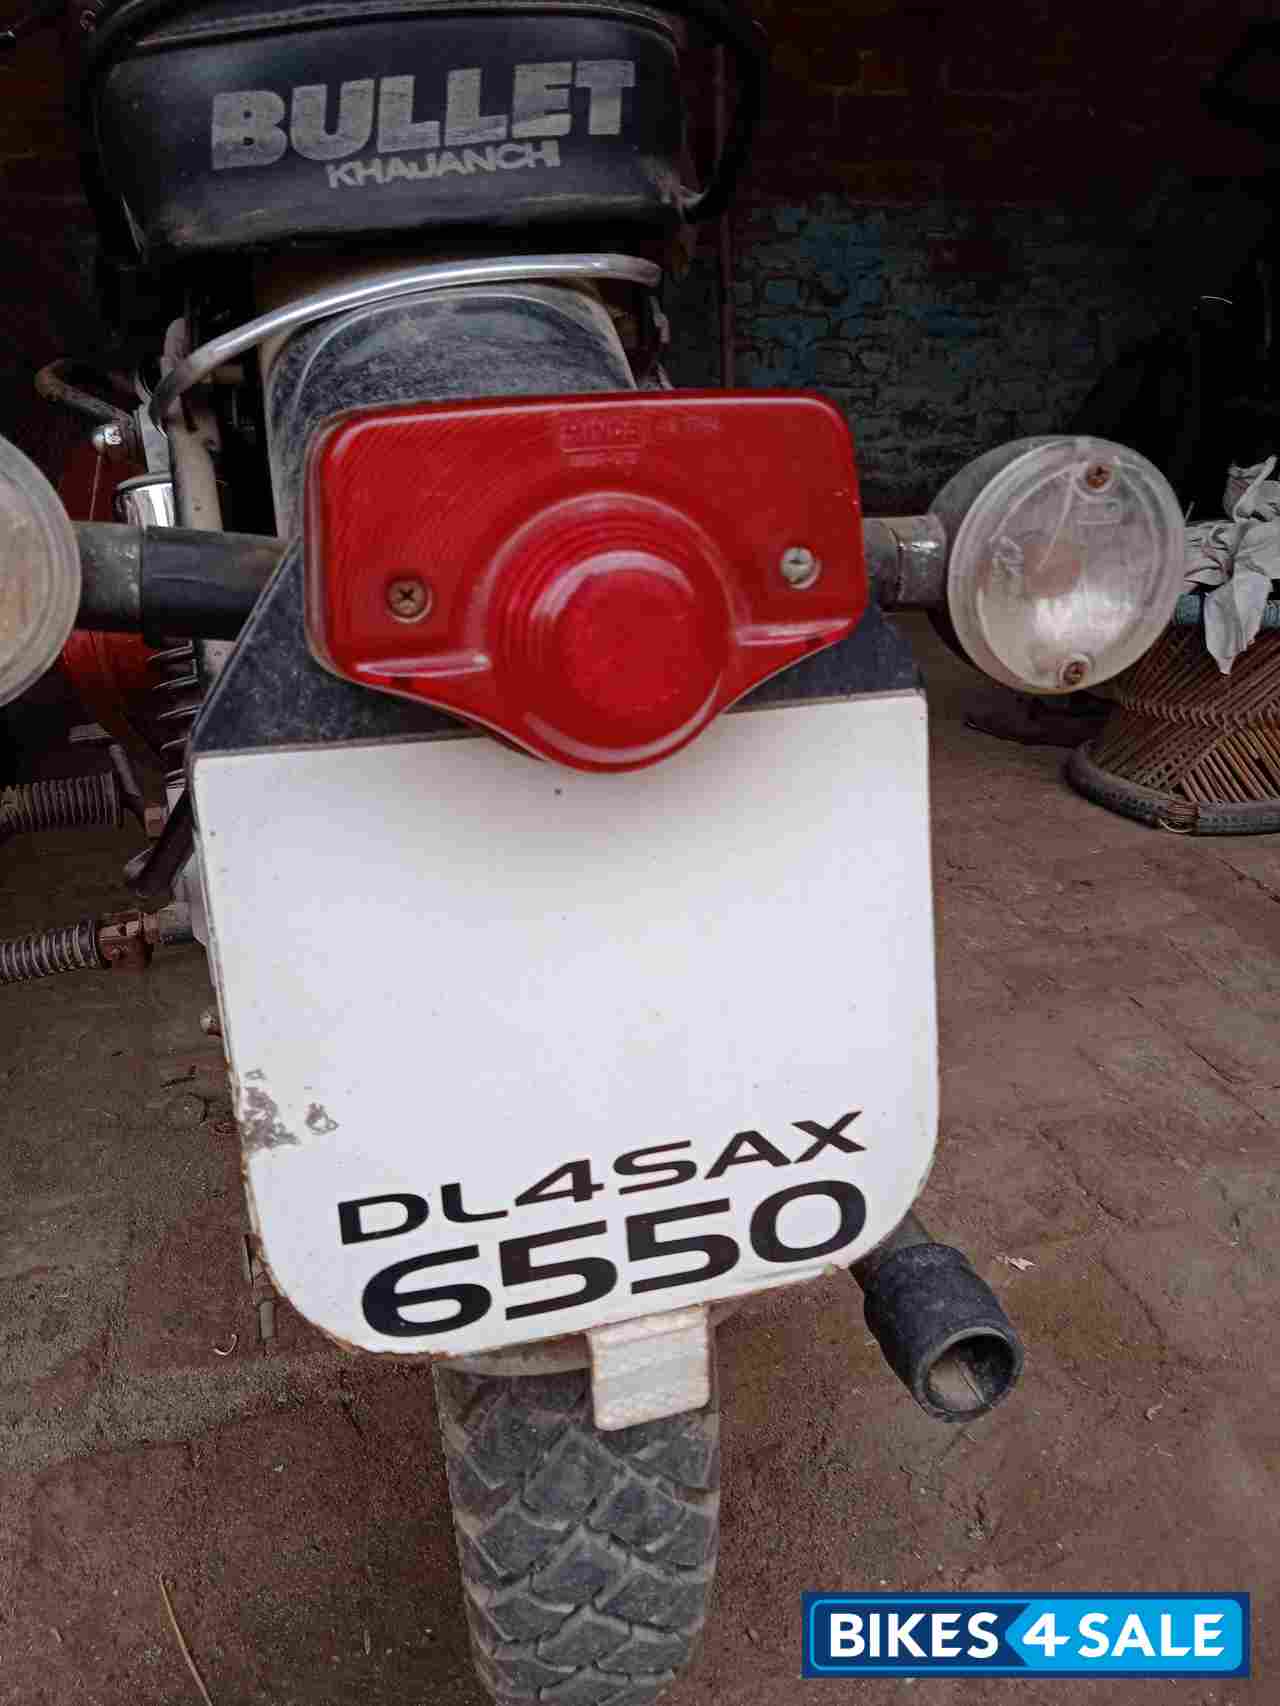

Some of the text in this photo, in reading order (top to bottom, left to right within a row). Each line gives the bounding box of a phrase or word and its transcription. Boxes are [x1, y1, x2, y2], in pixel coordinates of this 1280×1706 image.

[211, 60, 636, 170] BULLET
[324, 139, 561, 189] KHAJANCHI
[337, 1110, 867, 1245] DL4SAX
[361, 1179, 867, 1338] 6550
